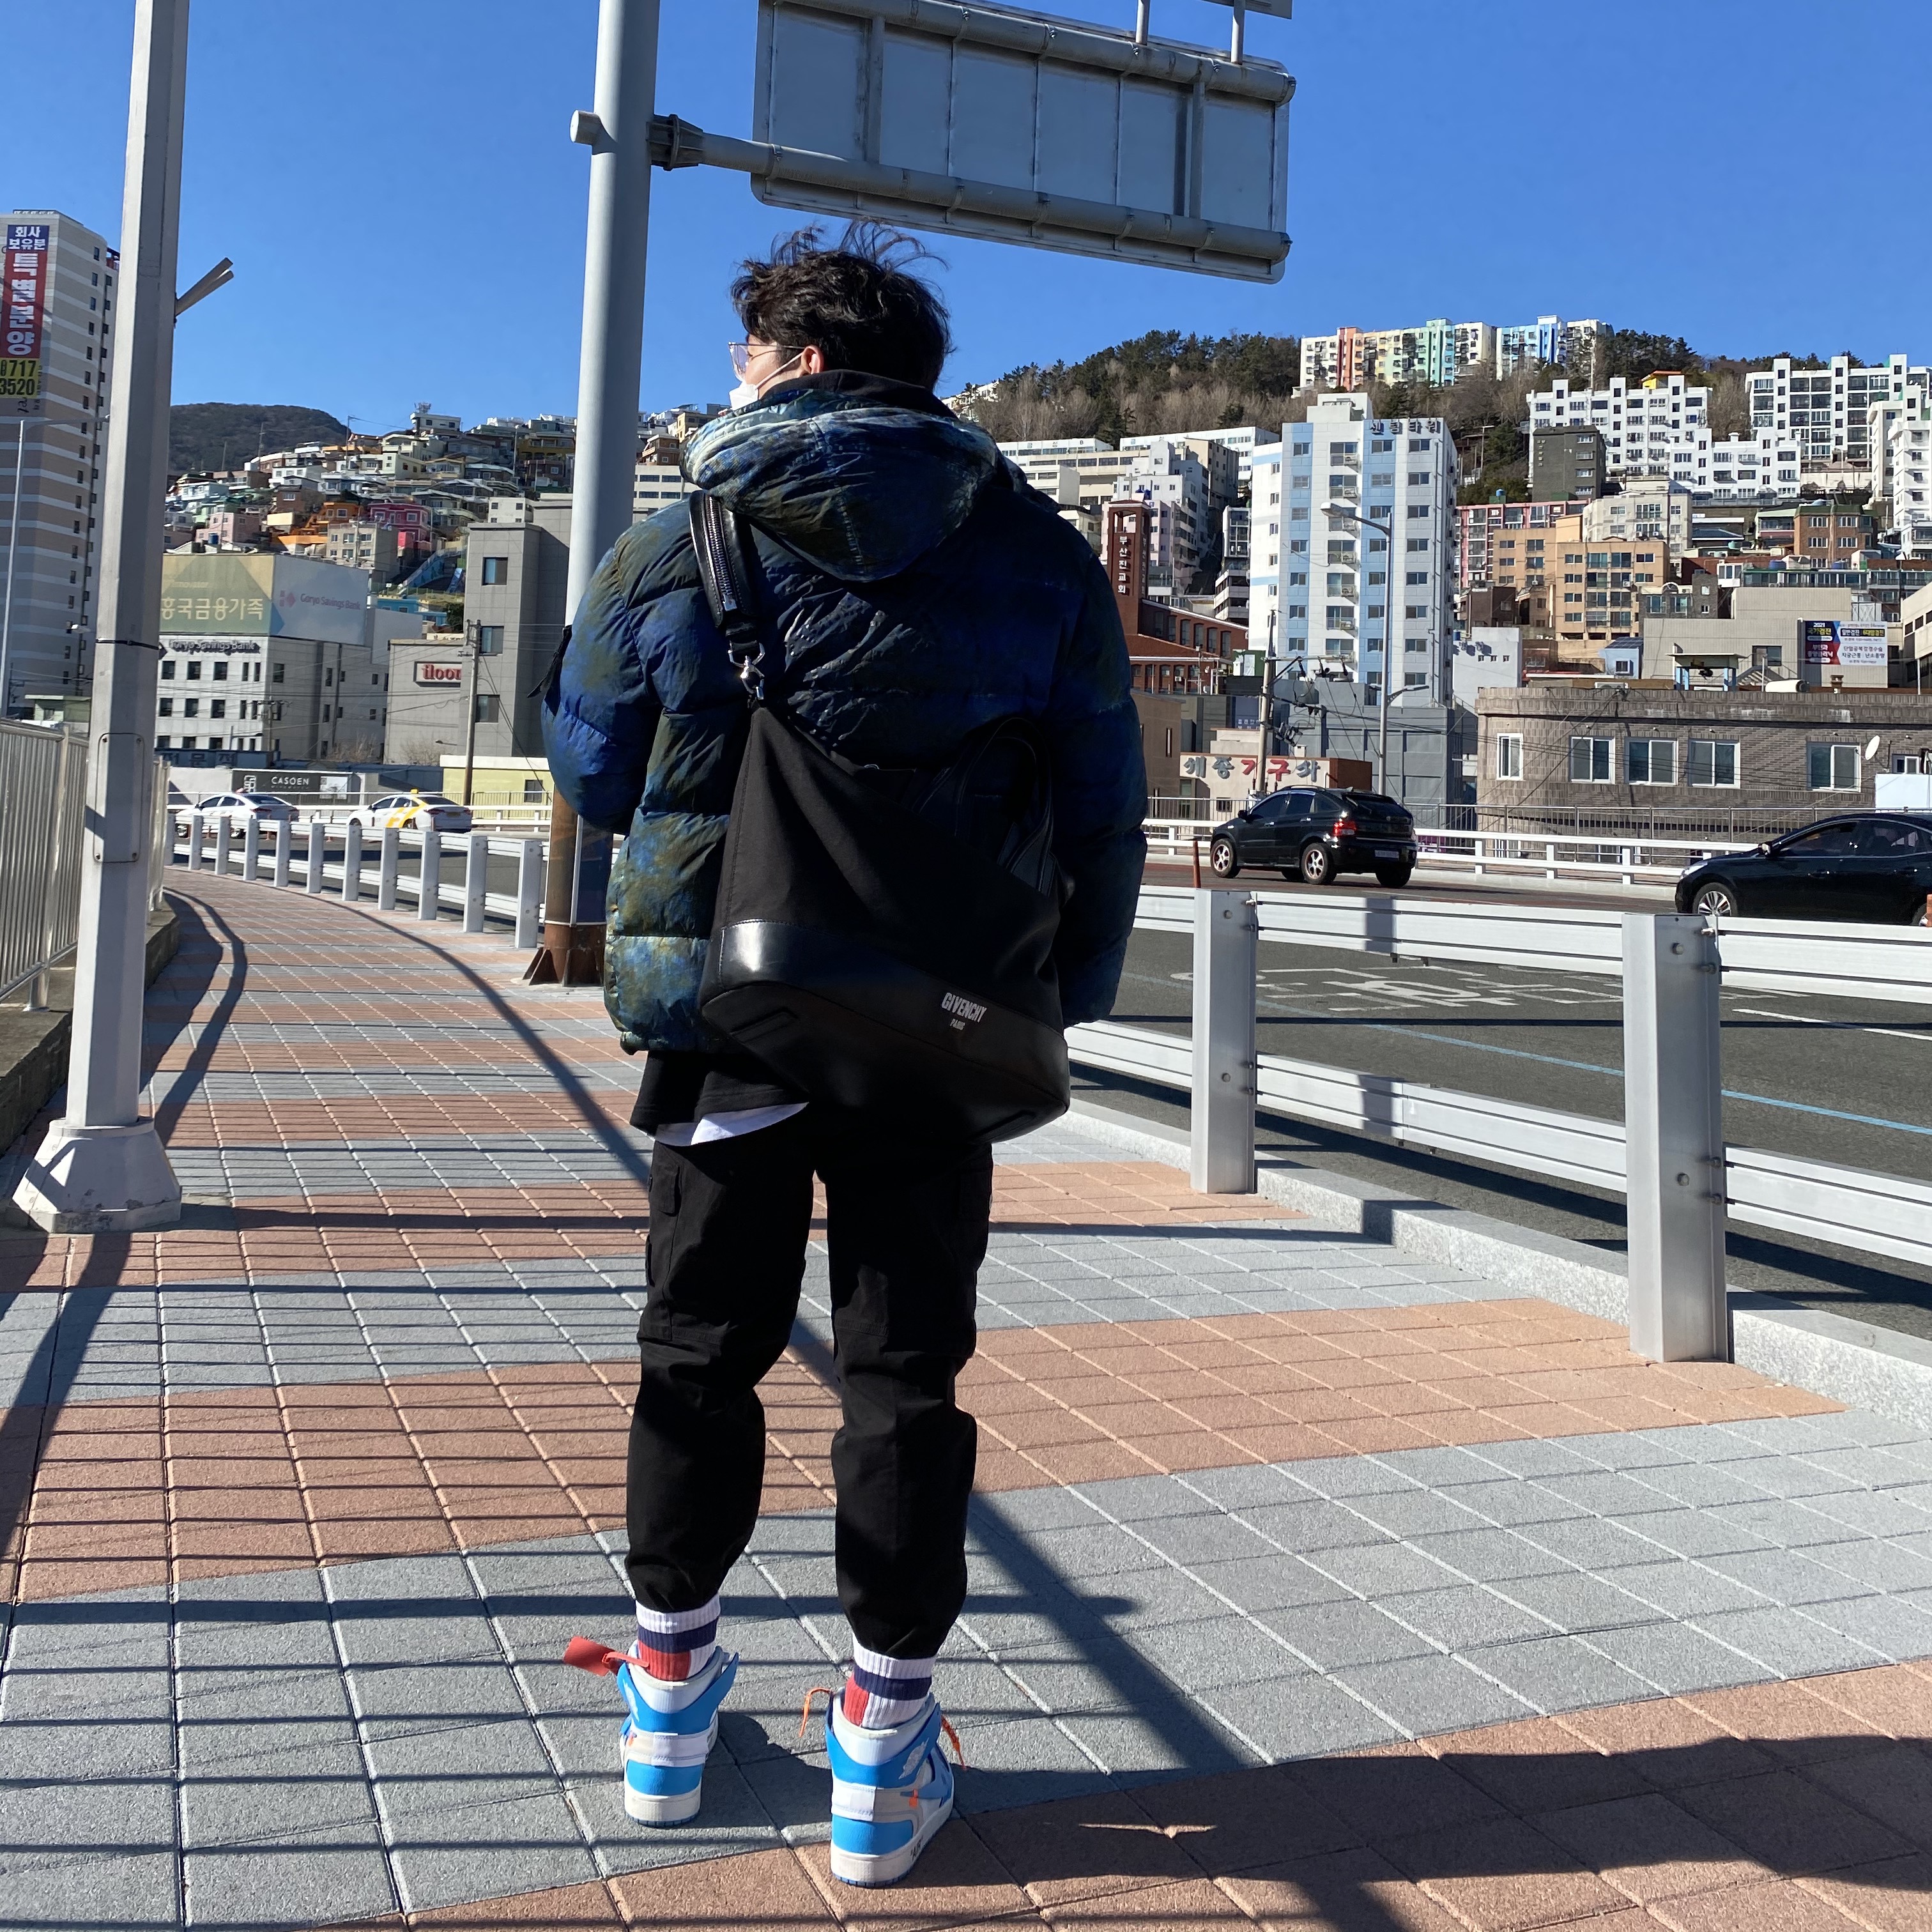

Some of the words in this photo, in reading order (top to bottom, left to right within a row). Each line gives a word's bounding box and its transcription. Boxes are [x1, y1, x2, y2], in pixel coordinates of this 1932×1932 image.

[15, 226, 41, 238] 회사
[8, 238, 45, 250] 보유분
[6, 253, 38, 355] 특별분양
[0, 378, 35, 395] 3520
[1370, 420, 1438, 434] 센텀타워
[1117, 536, 1128, 594] 부산진교회
[161, 597, 263, 620] 흥국금융가족
[271, 776, 310, 785] CASOEN
[941, 992, 988, 1022] GIVENCHY
